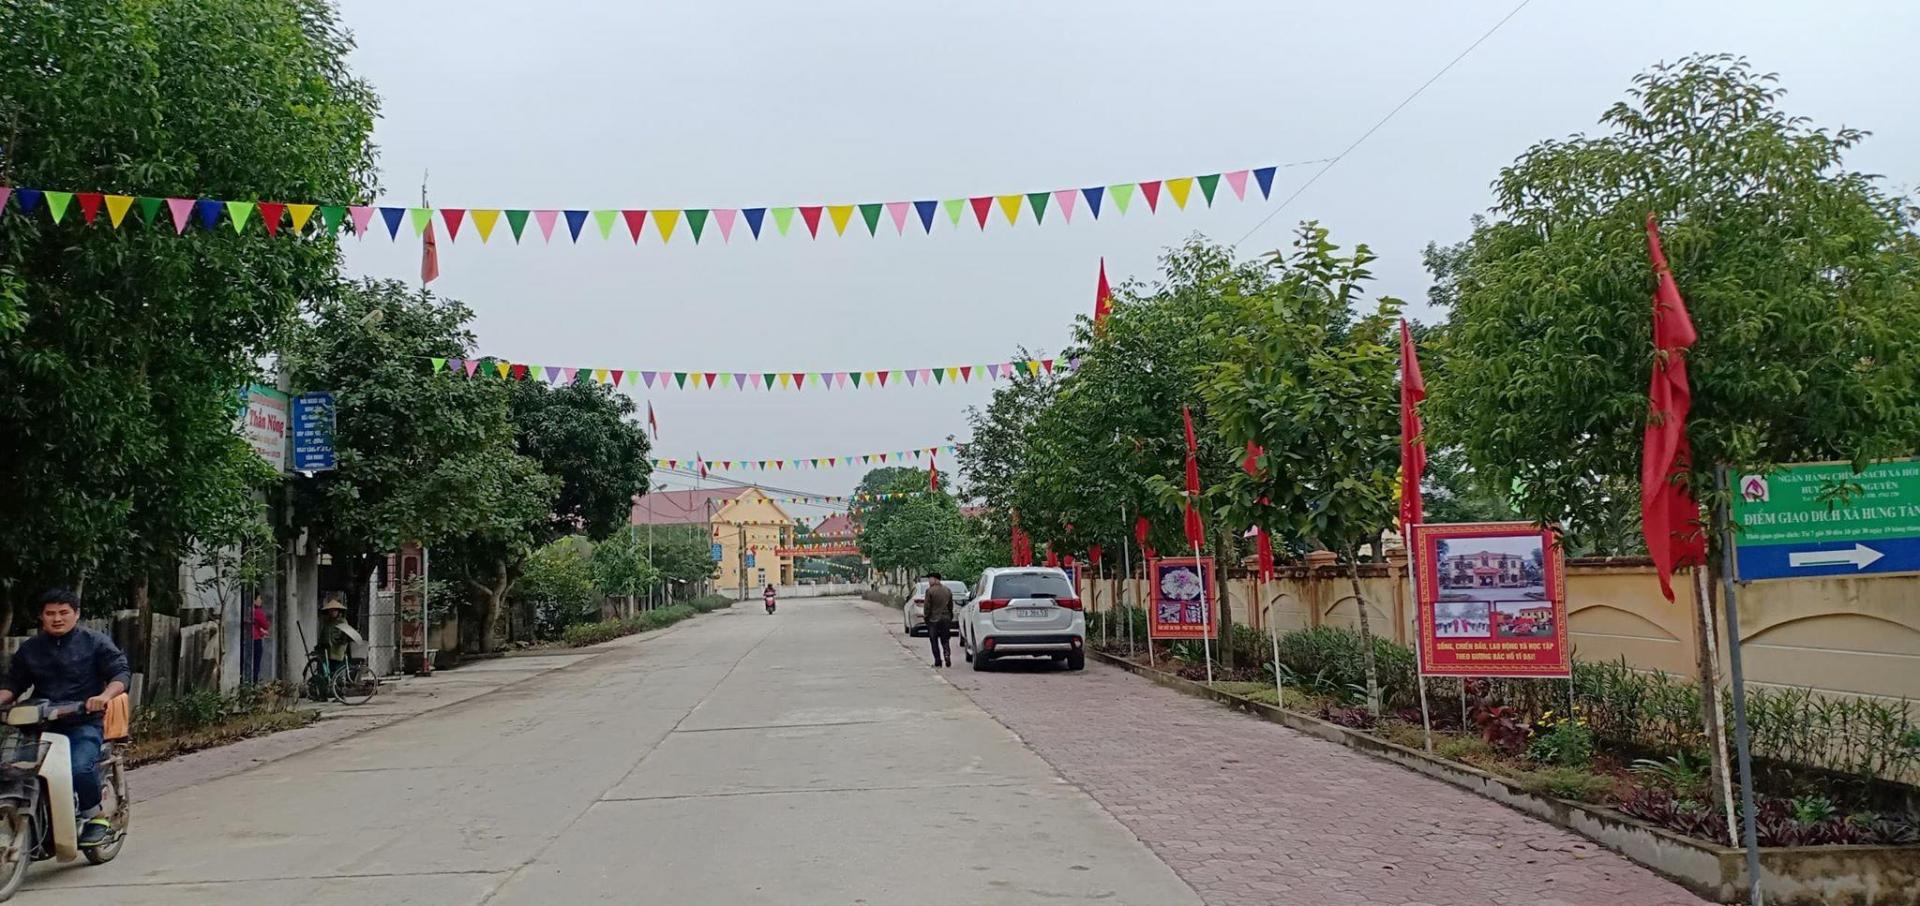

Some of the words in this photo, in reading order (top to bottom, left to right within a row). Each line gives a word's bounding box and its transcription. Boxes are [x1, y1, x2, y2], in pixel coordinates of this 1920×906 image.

[1744, 508, 1776, 526] ĐIỂM
[1778, 511, 1809, 524] GIAO
[1843, 505, 1860, 521] XÃ
